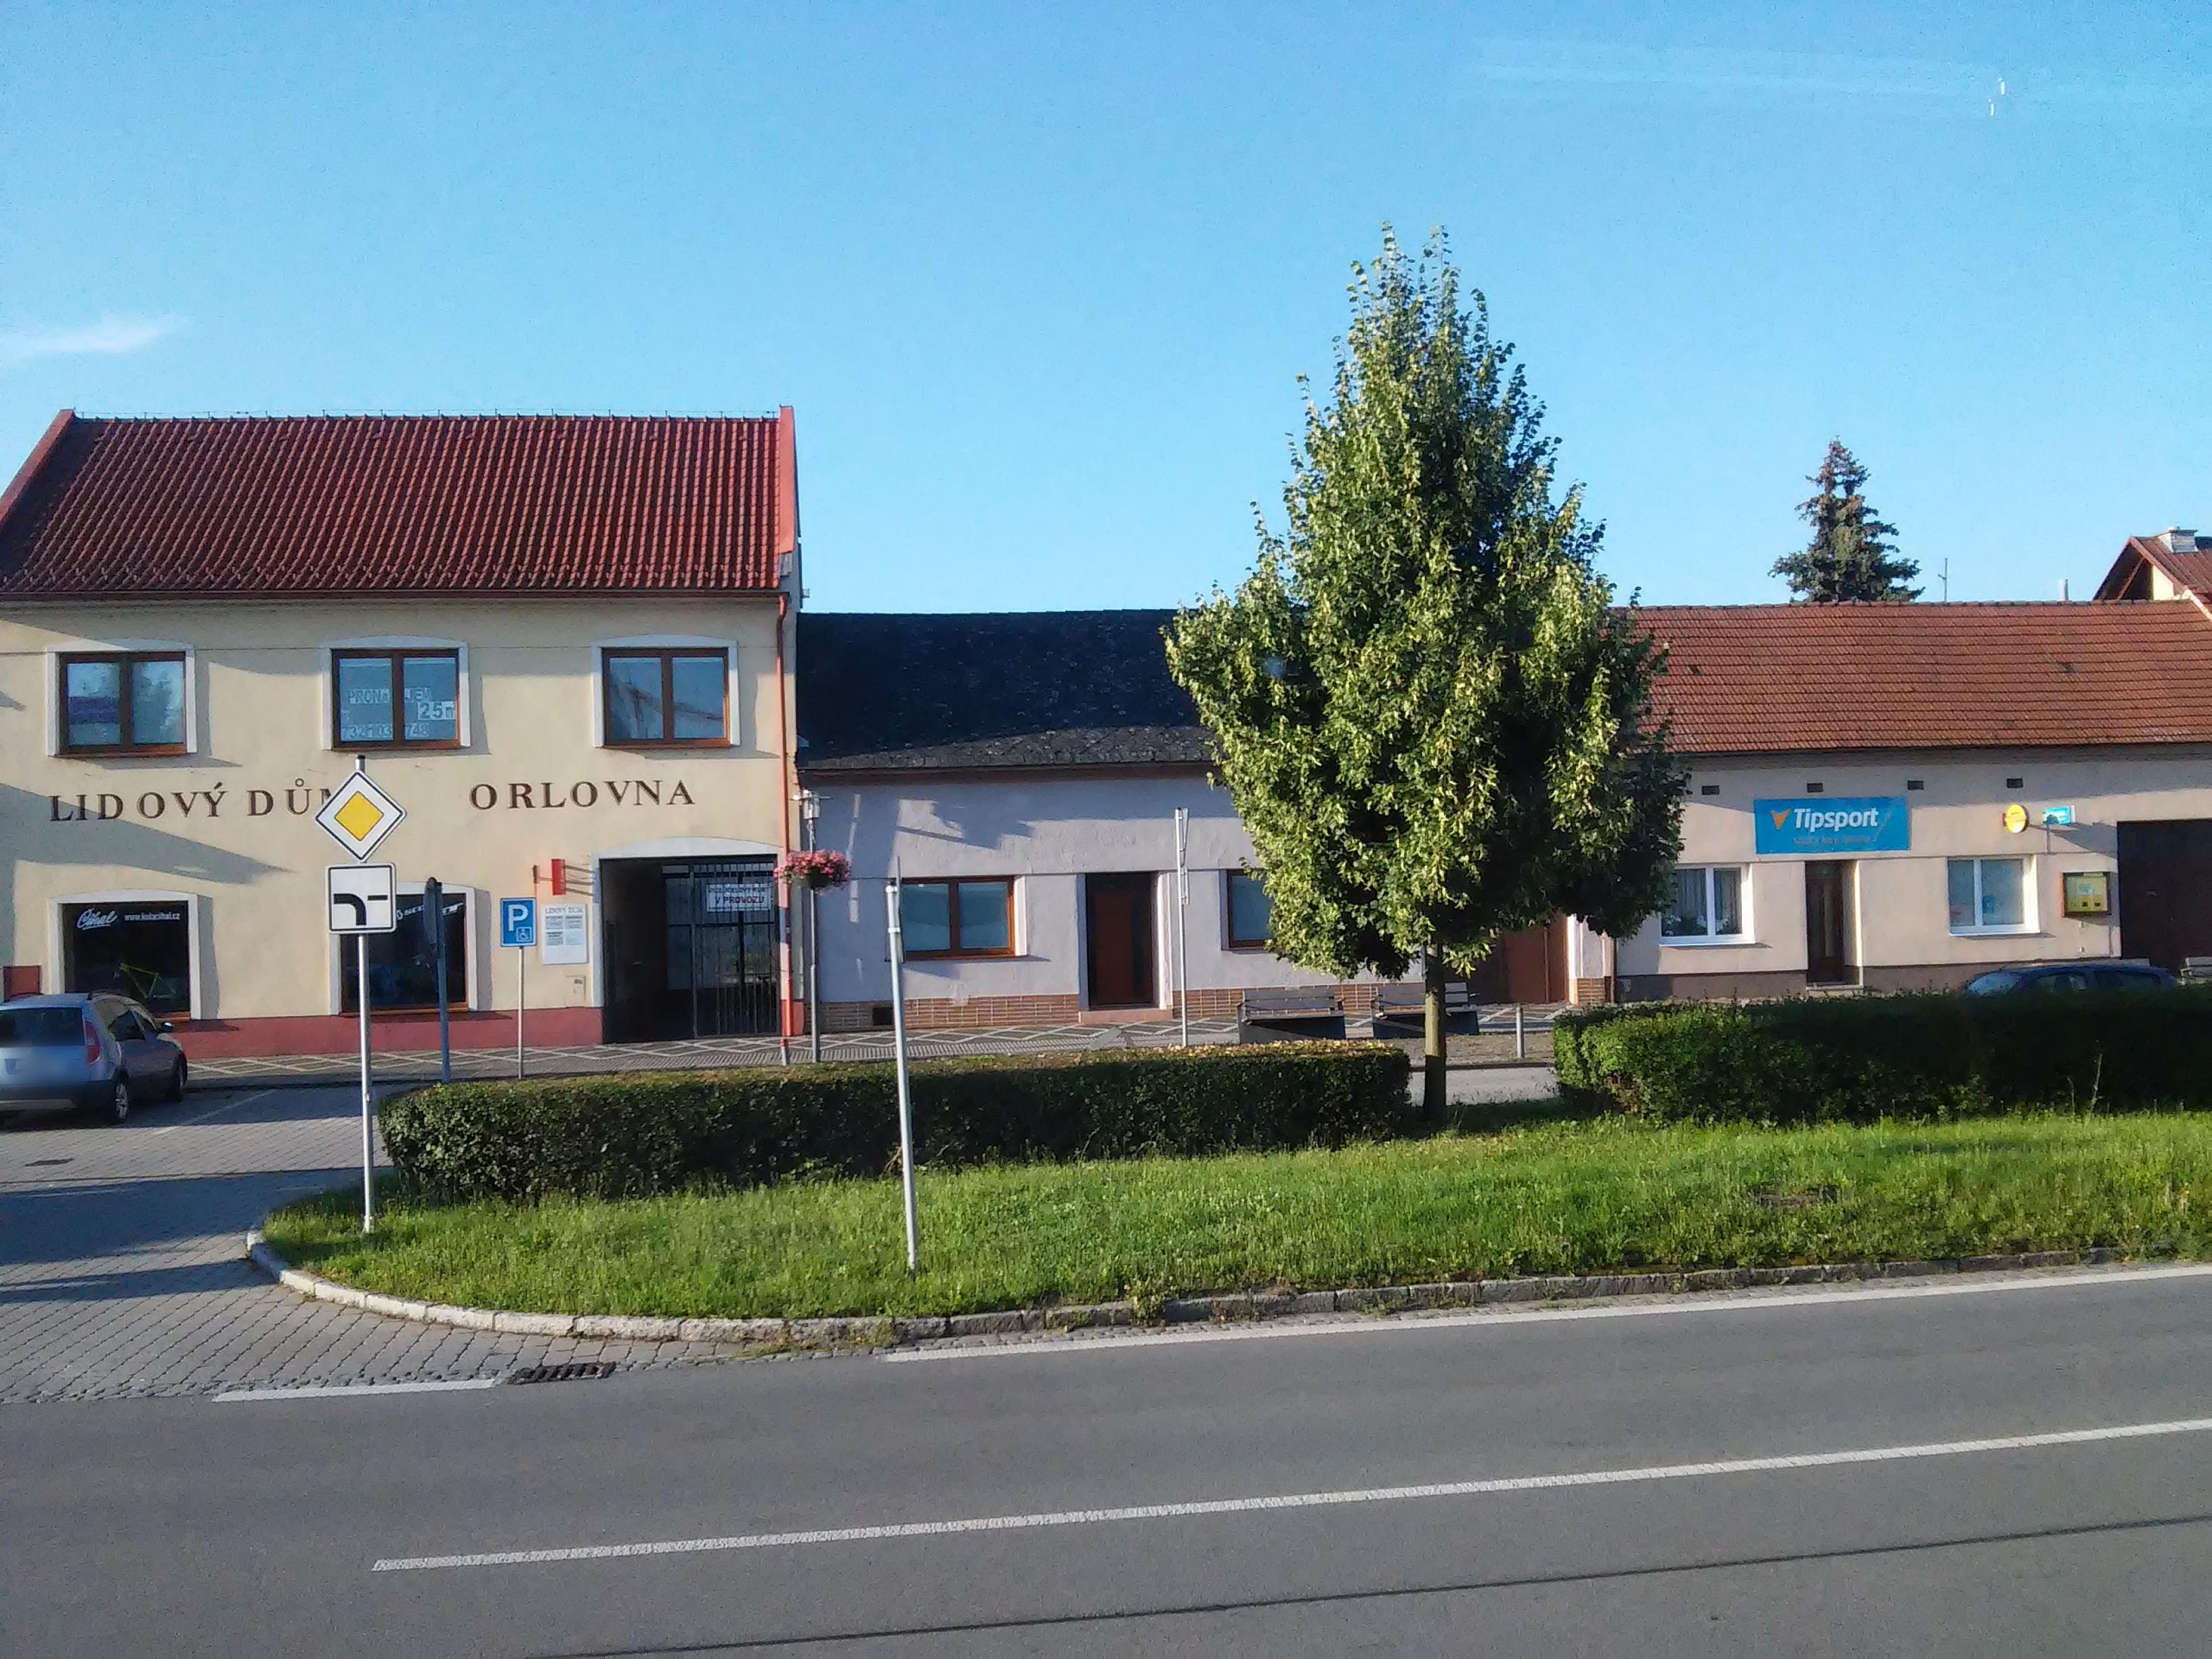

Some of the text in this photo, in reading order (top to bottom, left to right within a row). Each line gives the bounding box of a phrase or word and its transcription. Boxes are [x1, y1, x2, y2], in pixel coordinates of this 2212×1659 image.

[49, 782, 228, 822] LIDOVÝ
[469, 780, 696, 810] ORLOVNA
[1794, 807, 1879, 833] Tipsport
[723, 896, 765, 904] PROVOZU
[508, 904, 528, 931] P
